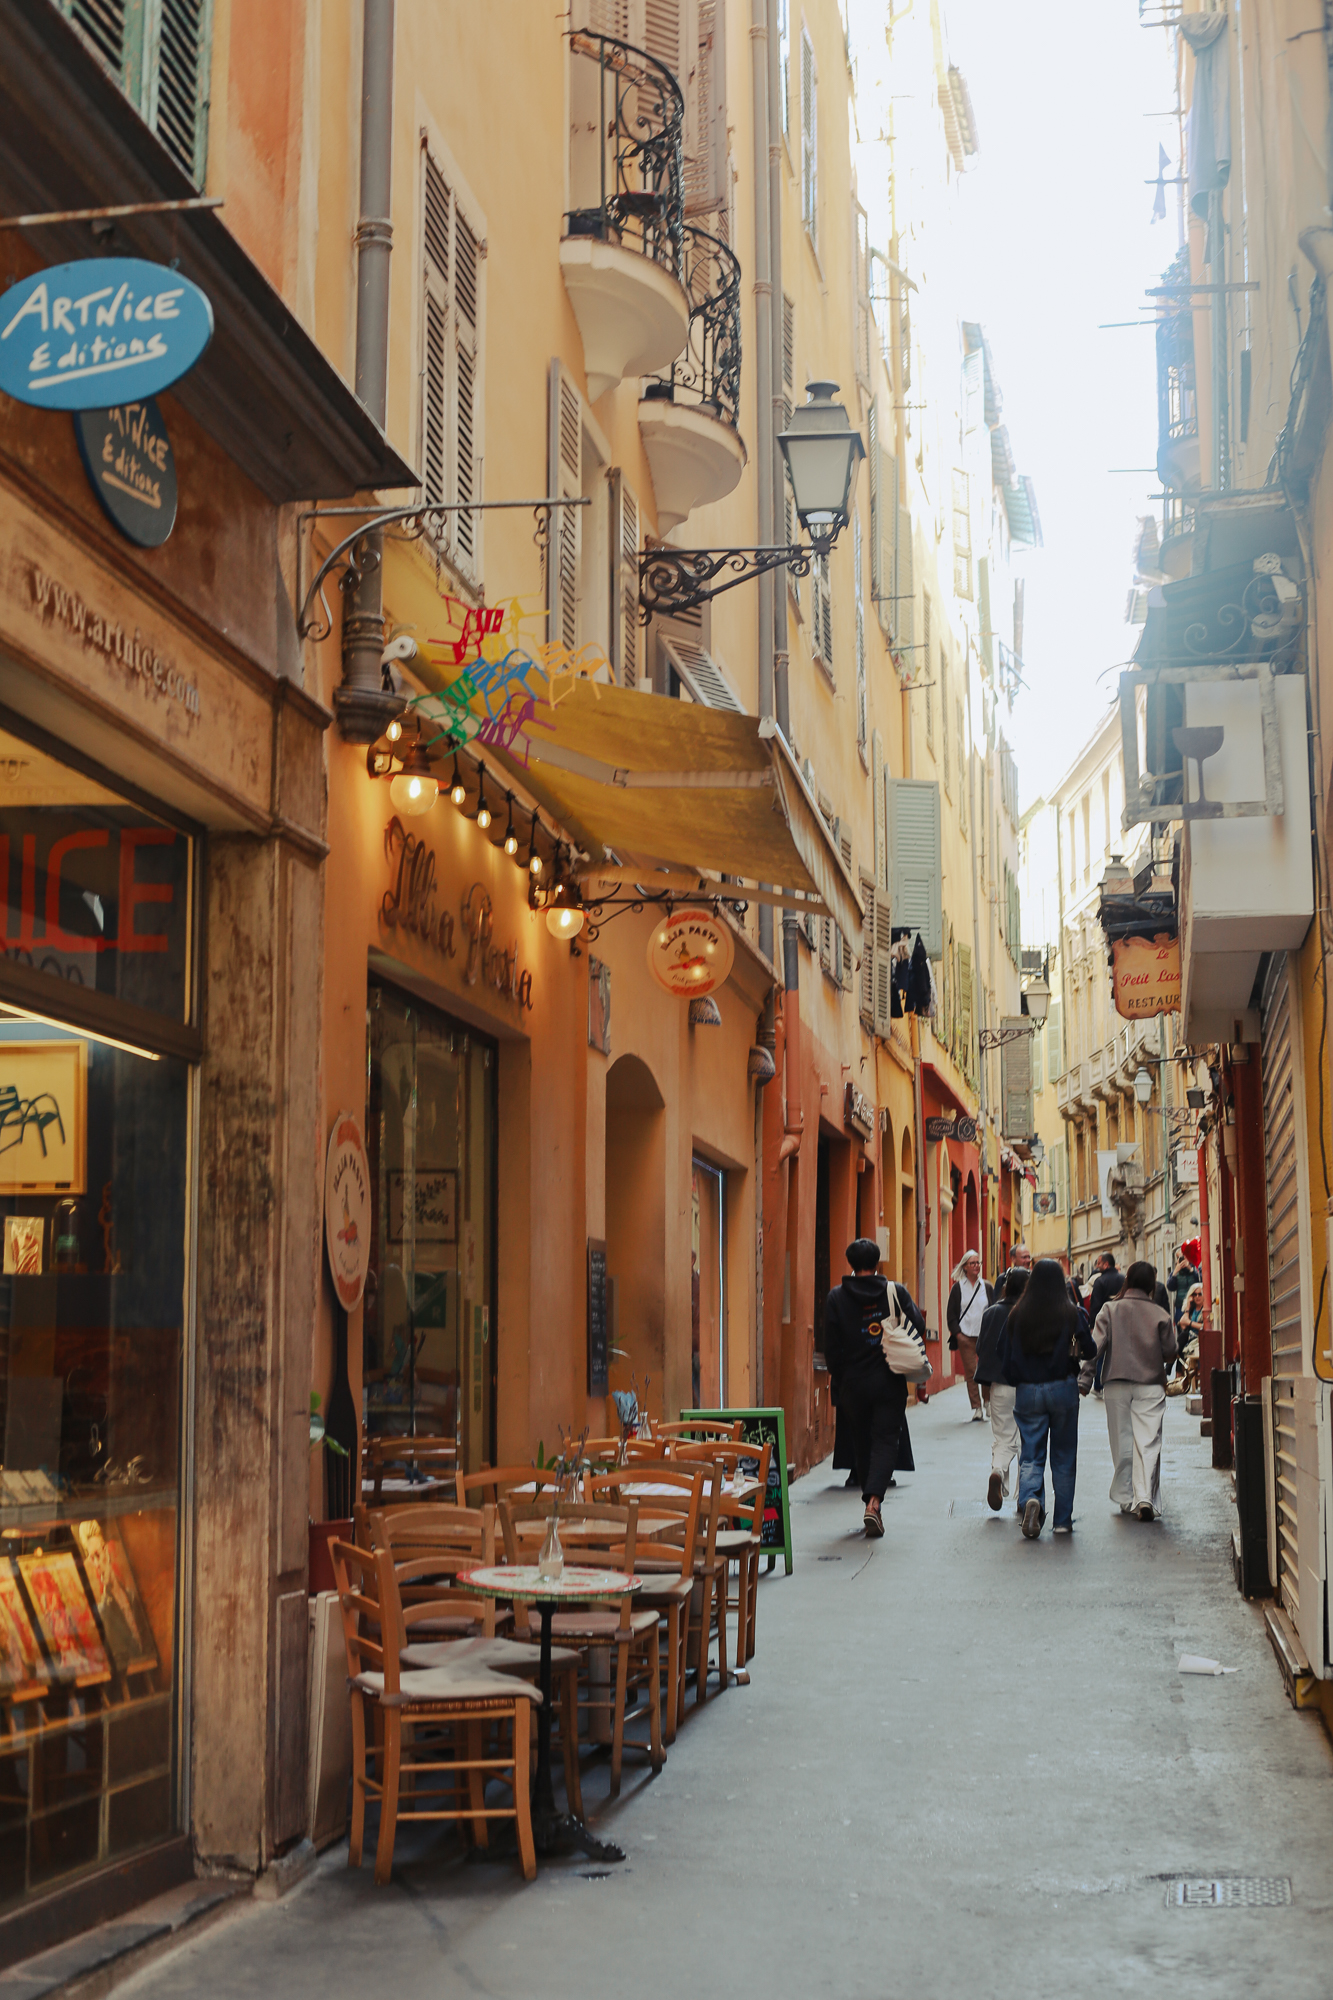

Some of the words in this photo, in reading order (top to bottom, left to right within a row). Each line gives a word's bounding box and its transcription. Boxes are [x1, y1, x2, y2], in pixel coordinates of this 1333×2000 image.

[28, 333, 168, 372] Editions
[102, 432, 161, 500] Editions
[33, 569, 201, 717] www.artnice.com
[688, 925, 719, 946] PASTA
[1156, 949, 1170, 960] Le
[1120, 972, 1150, 988] Petit
